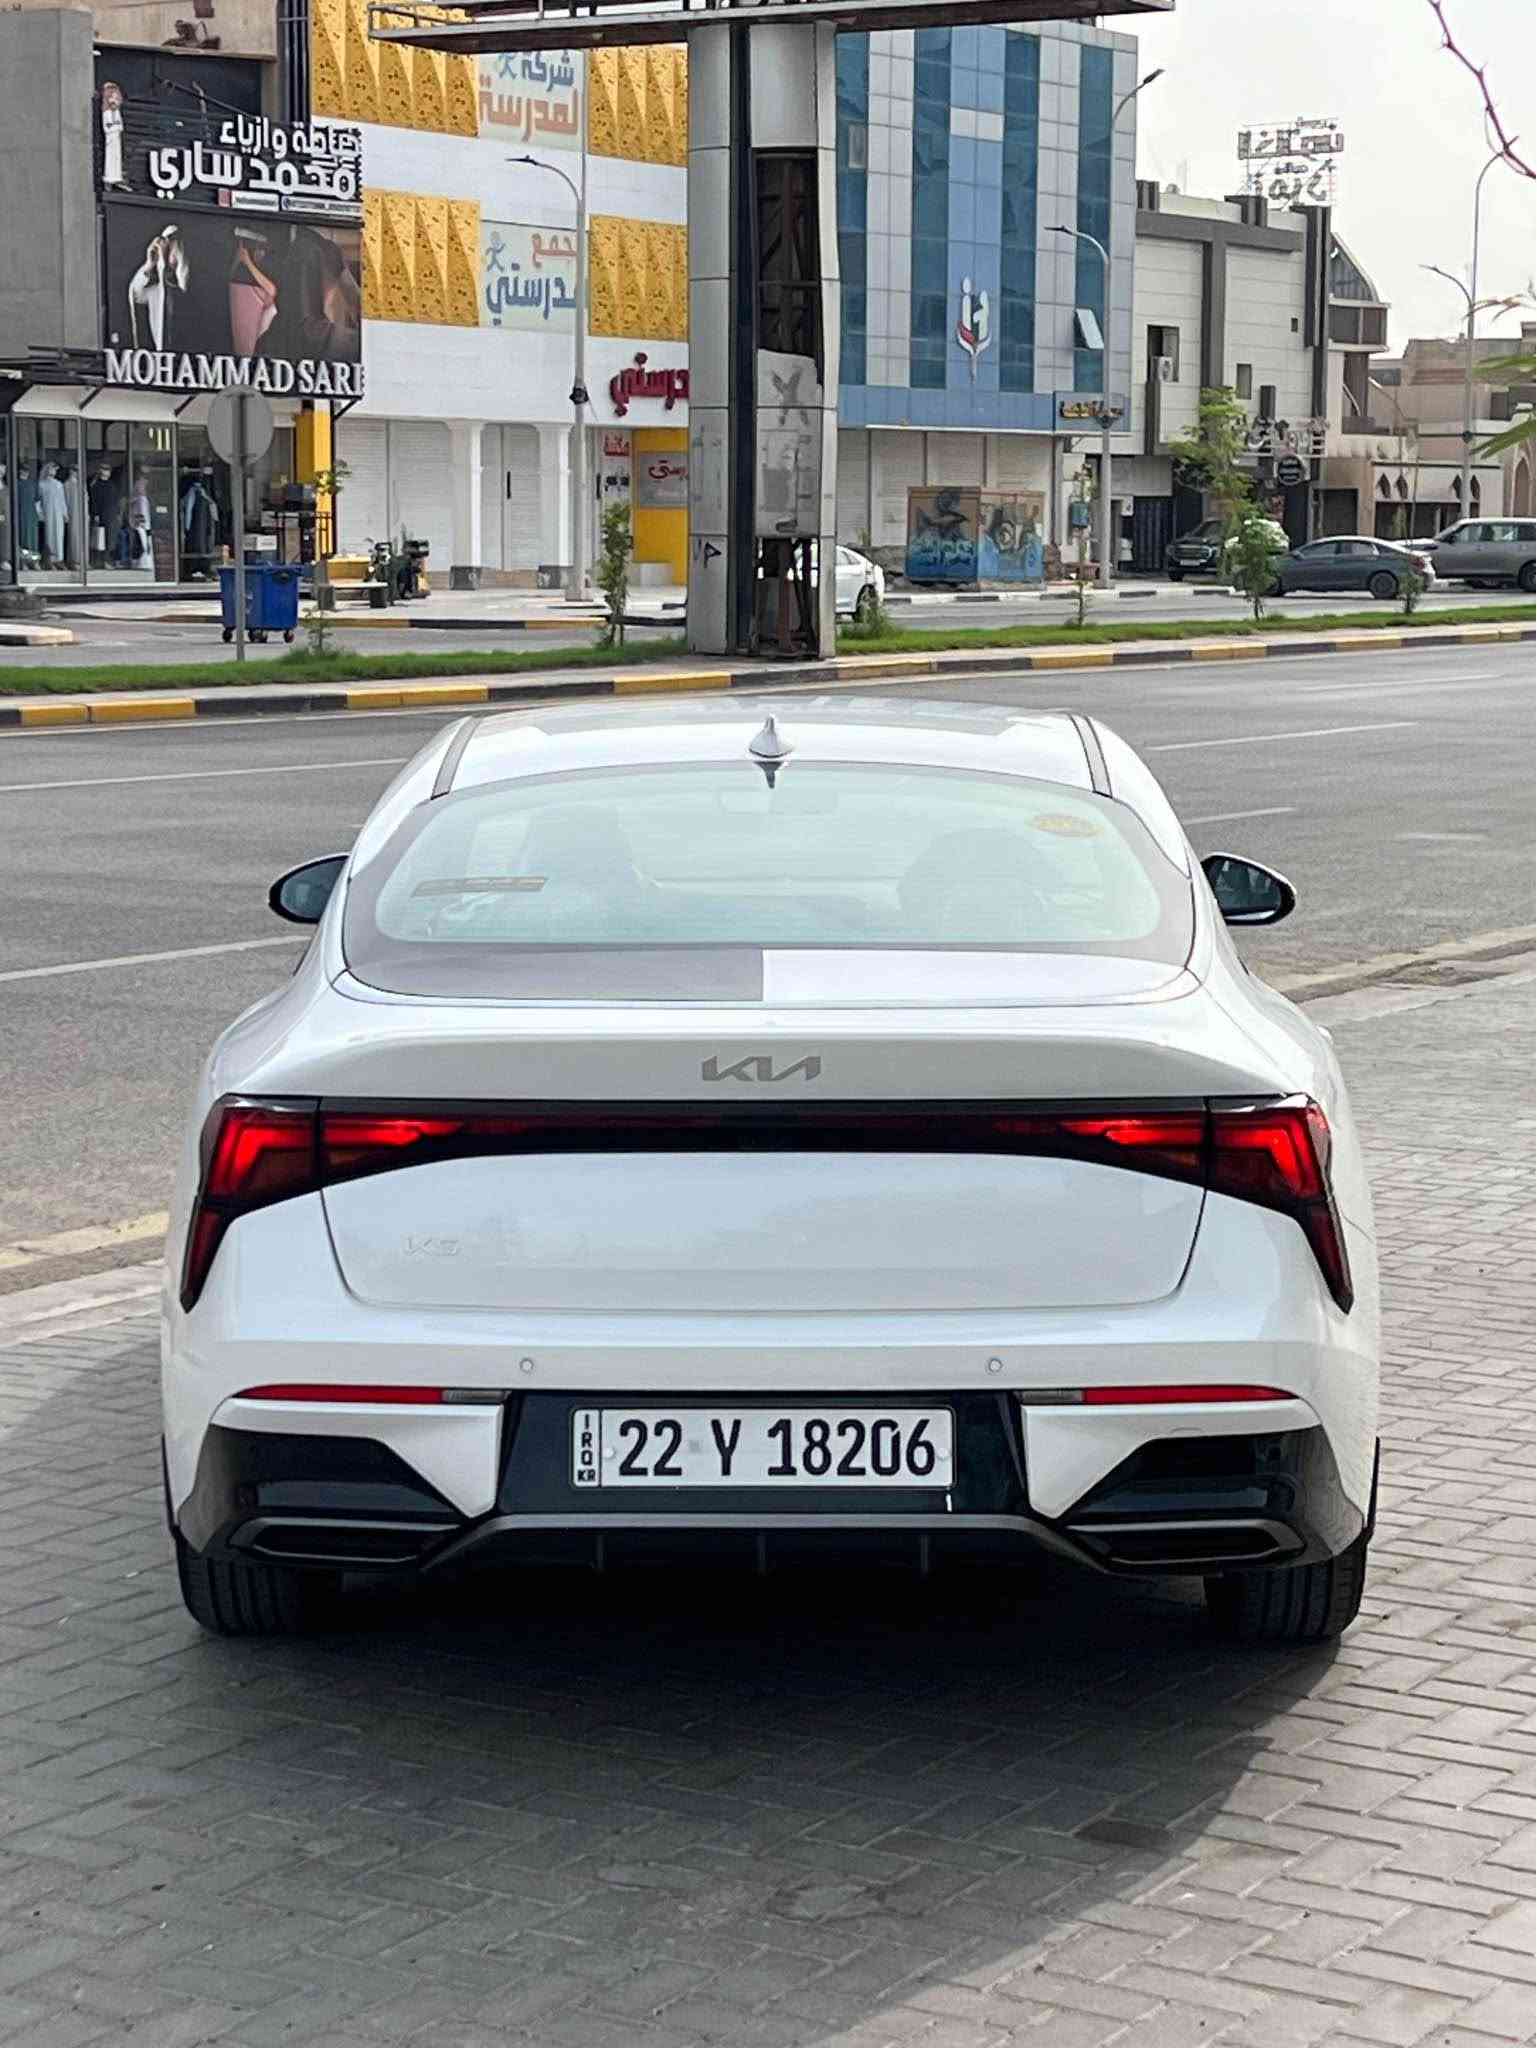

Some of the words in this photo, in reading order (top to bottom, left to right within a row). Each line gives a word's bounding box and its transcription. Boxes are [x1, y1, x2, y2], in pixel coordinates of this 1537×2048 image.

[480, 74, 579, 142] لمدرسة
[150, 141, 242, 199] ساري
[249, 158, 356, 200] محمد
[486, 262, 577, 326] درستي
[104, 349, 294, 393] MOHAMMAD
[609, 352, 689, 418] درستي
[702, 1055, 821, 1081] KIA
[619, 1418, 683, 1477] 22
[711, 1418, 742, 1477] Y
[767, 1418, 936, 1477] 18206
